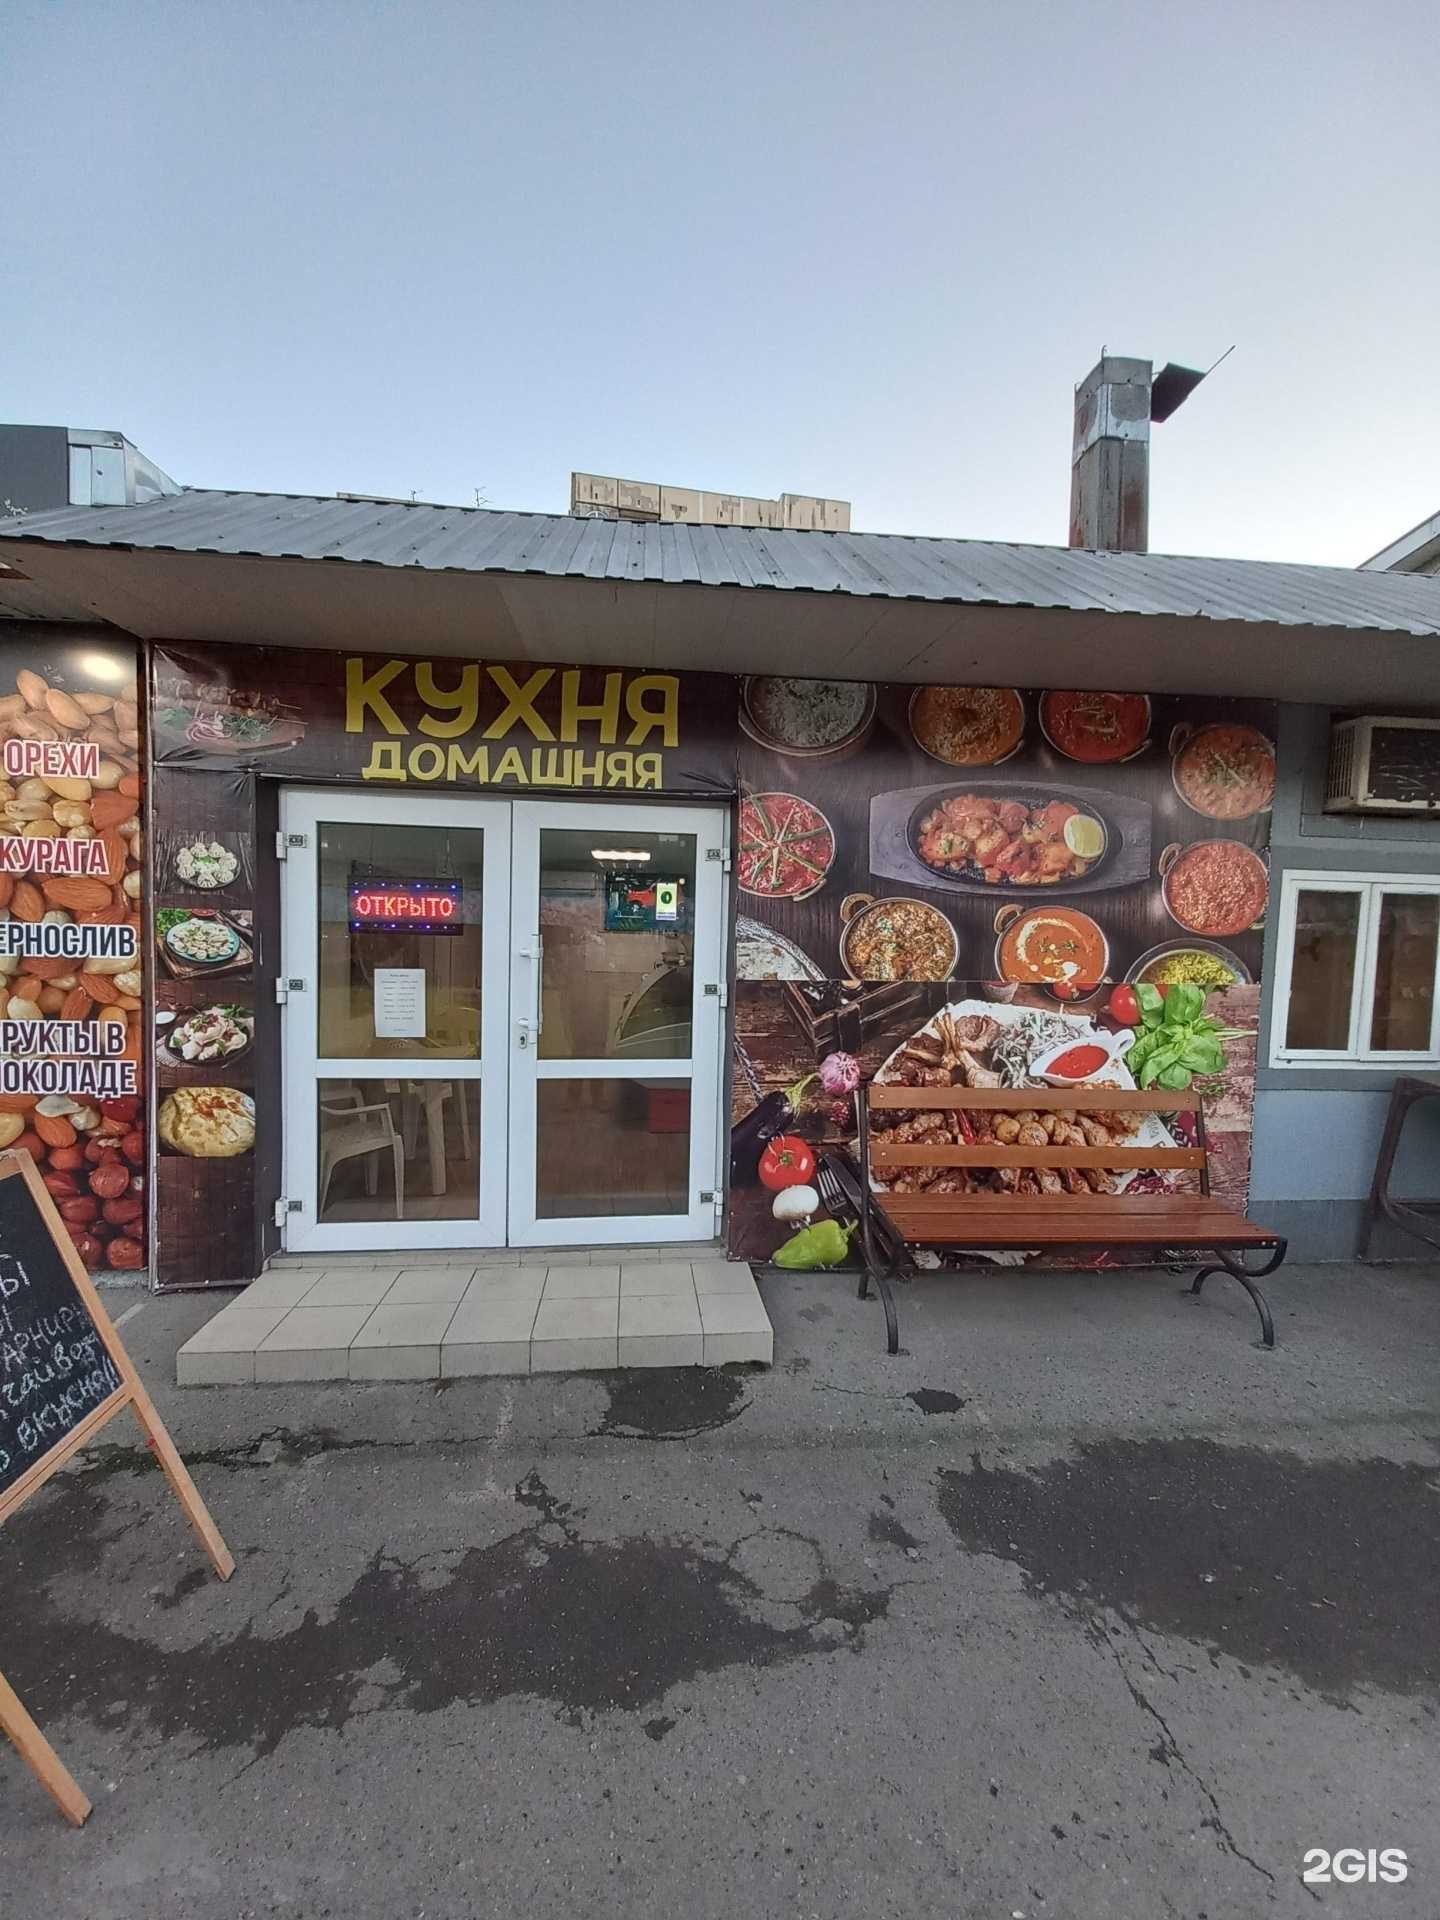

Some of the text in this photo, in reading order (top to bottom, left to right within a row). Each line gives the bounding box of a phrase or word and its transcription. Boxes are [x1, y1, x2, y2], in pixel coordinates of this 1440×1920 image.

[345, 657, 680, 748] КУХНЯ
[5, 740, 99, 777] ОРЕХИ
[361, 740, 664, 790] ДОМАШНЯЯ
[0, 837, 108, 873] КУРАГА
[357, 895, 454, 917] ОТКРЫТО
[107, 1022, 125, 1054] В
